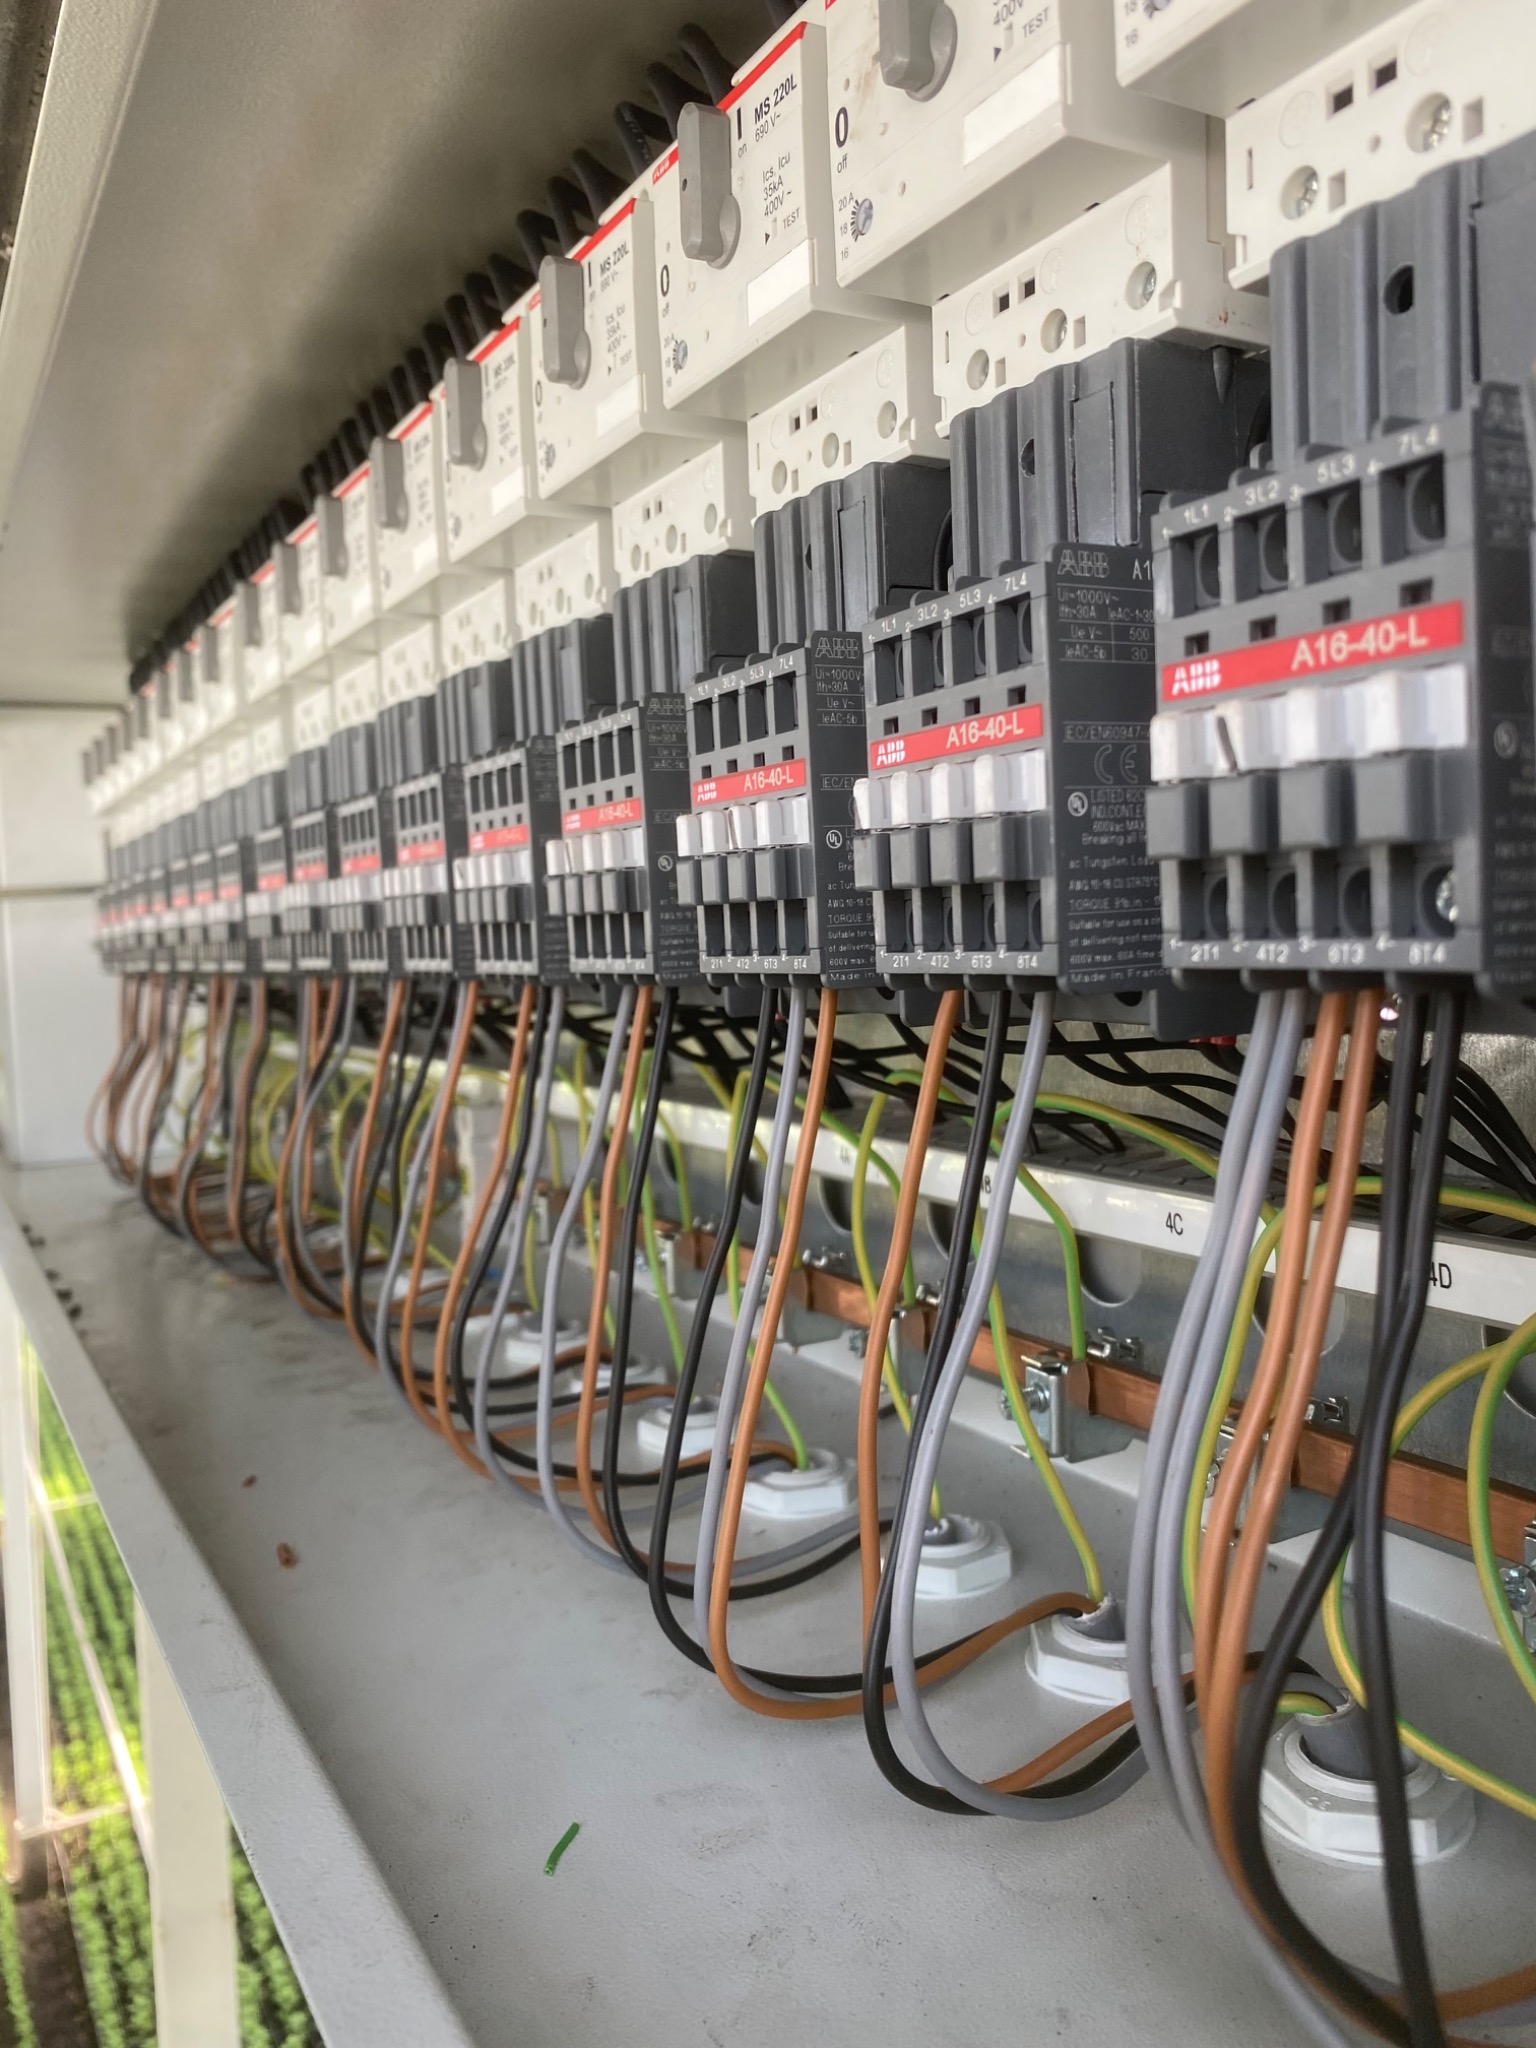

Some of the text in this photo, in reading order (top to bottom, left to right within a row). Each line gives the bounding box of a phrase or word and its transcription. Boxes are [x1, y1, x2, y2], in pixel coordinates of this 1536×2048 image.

[1023, 6, 1050, 38] TEST
[1125, 28, 1138, 48] 16
[754, 73, 797, 125] MS 220L
[755, 120, 769, 142] 690
[835, 106, 849, 148] 0
[738, 143, 747, 158] on
[653, 157, 670, 181] ABB
[778, 152, 790, 171] Icu
[837, 153, 848, 173] off
[763, 175, 784, 201] 35kA
[764, 190, 784, 217] 400V
[838, 192, 854, 212] 20 A
[783, 207, 800, 230] TEST
[839, 222, 848, 236] 18
[600, 241, 629, 277] MS 220L
[841, 247, 849, 261] 16
[1184, 503, 1209, 525] 1L1
[1245, 481, 1280, 504] 3L2
[1317, 454, 1356, 484] 5L3
[1399, 423, 1441, 452] 7L4
[1057, 549, 1110, 578] ABB
[881, 618, 897, 632] 1L1
[917, 603, 938, 621] 3L2
[959, 589, 981, 608] 5L3
[1004, 572, 1027, 592] 7L4
[1129, 627, 1150, 641] 500
[815, 637, 859, 659] ABB
[1132, 647, 1148, 660] 30
[1172, 614, 1430, 695] ABB A16-40-L
[722, 675, 737, 688] 3L2
[750, 666, 764, 680] 5L3
[779, 655, 794, 670] 7L4
[647, 697, 684, 716] ABB
[827, 697, 839, 709] Ue
[876, 711, 1024, 766] ABB A16-40-L
[1064, 725, 1151, 740] IEC/EN60947-
[697, 765, 794, 802] ABB A16-40-L
[828, 899, 844, 908] AWG
[828, 914, 863, 924] TORQUE
[828, 931, 855, 940] Suitable
[711, 959, 723, 969] 2T1
[737, 959, 750, 969] 4T2
[764, 959, 778, 969] 6T3
[793, 959, 807, 969] 8T4
[893, 955, 909, 967] 2T1
[930, 955, 949, 968] 4T2
[971, 955, 992, 968] 6T3
[1017, 955, 1038, 969] 8T4
[831, 972, 860, 981] Made
[1070, 973, 1106, 983] Made
[1165, 1211, 1184, 1236] 4C
